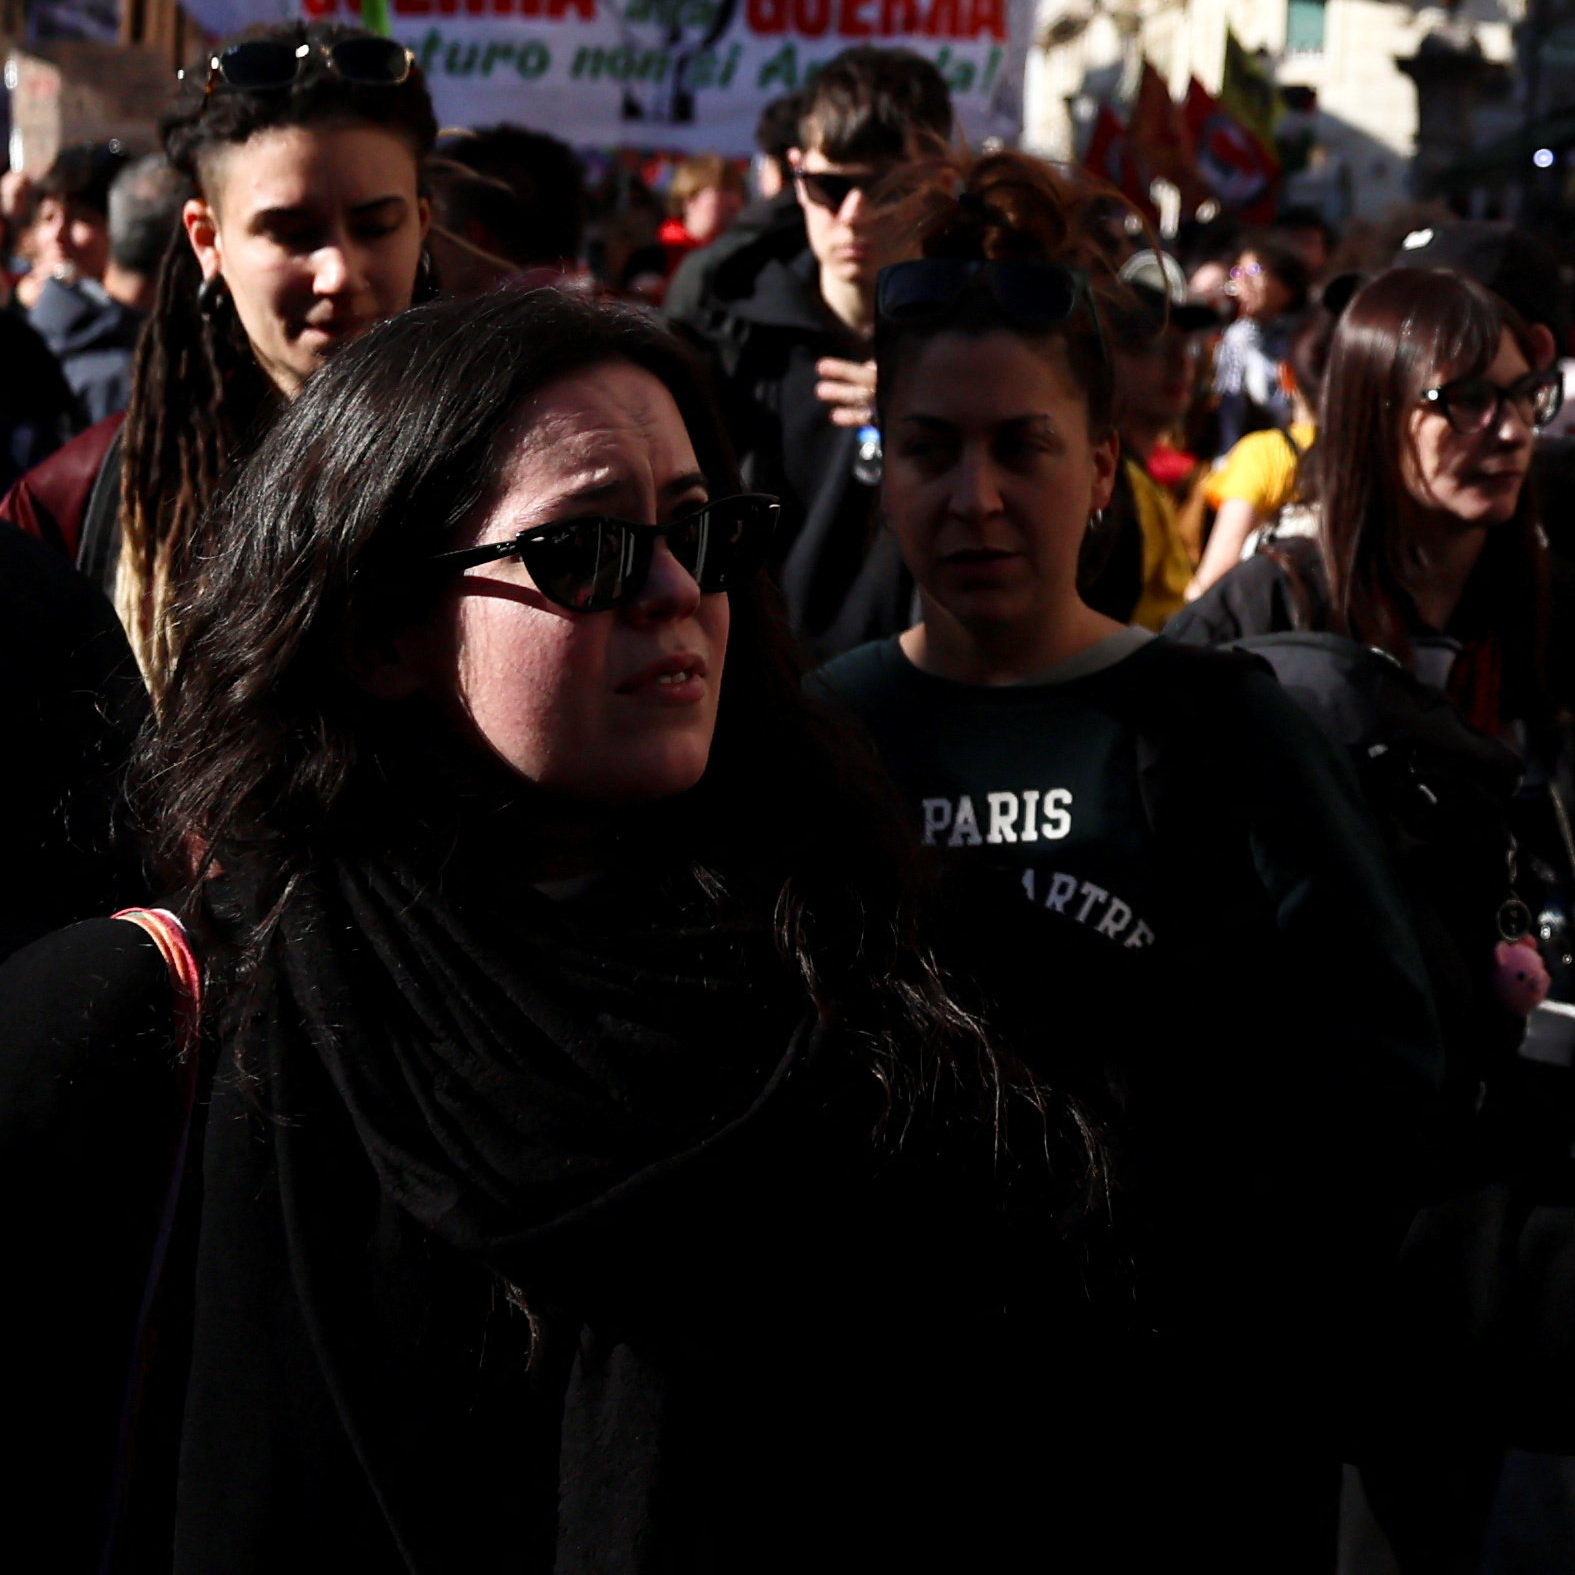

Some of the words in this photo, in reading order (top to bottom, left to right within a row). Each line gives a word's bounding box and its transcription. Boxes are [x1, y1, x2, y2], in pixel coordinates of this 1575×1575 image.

[417, 28, 550, 77] turo
[569, 45, 672, 82] non
[921, 788, 1074, 847] PARIS
